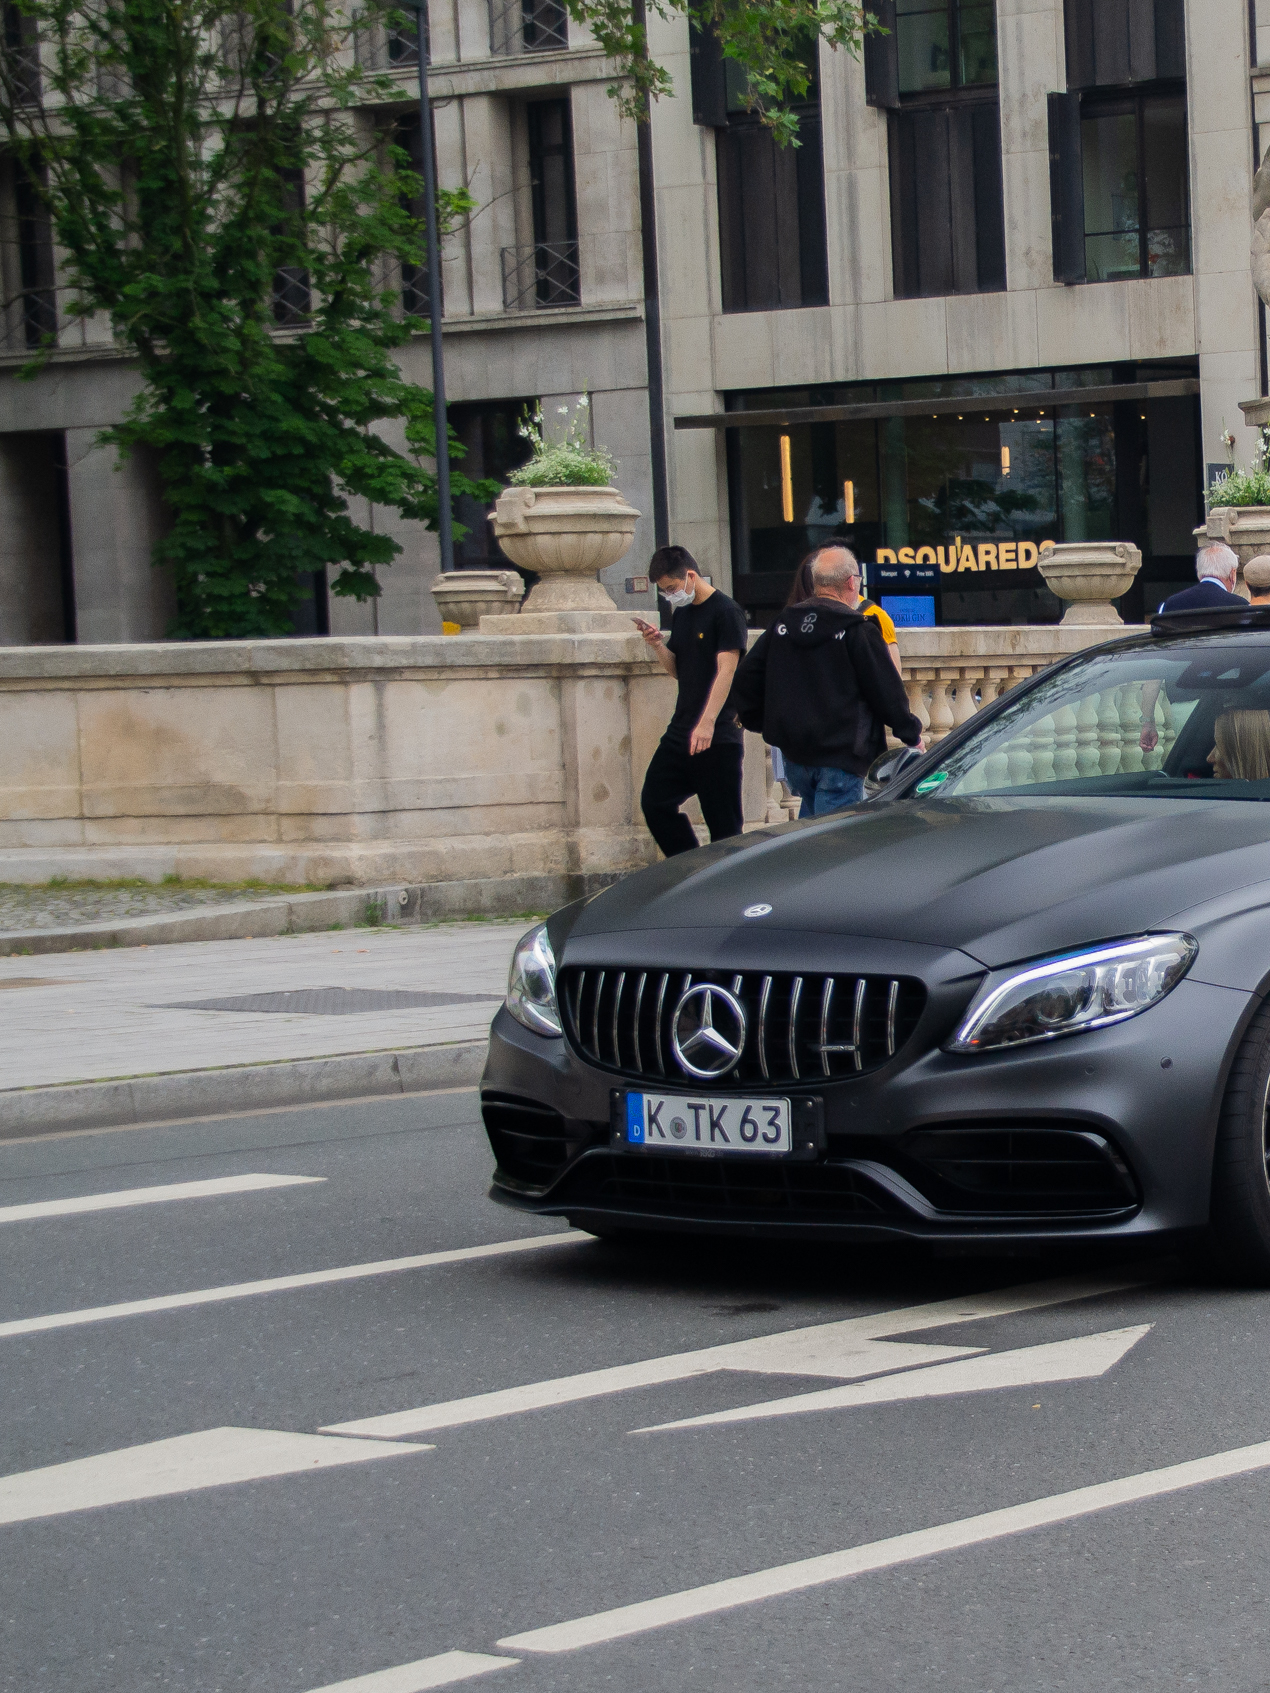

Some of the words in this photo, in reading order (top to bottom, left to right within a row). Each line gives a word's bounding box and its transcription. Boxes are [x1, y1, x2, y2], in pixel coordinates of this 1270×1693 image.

[633, 1125, 641, 1137] D
[647, 1098, 667, 1138] K
[687, 1102, 731, 1143] TK
[739, 1104, 783, 1144] 63
